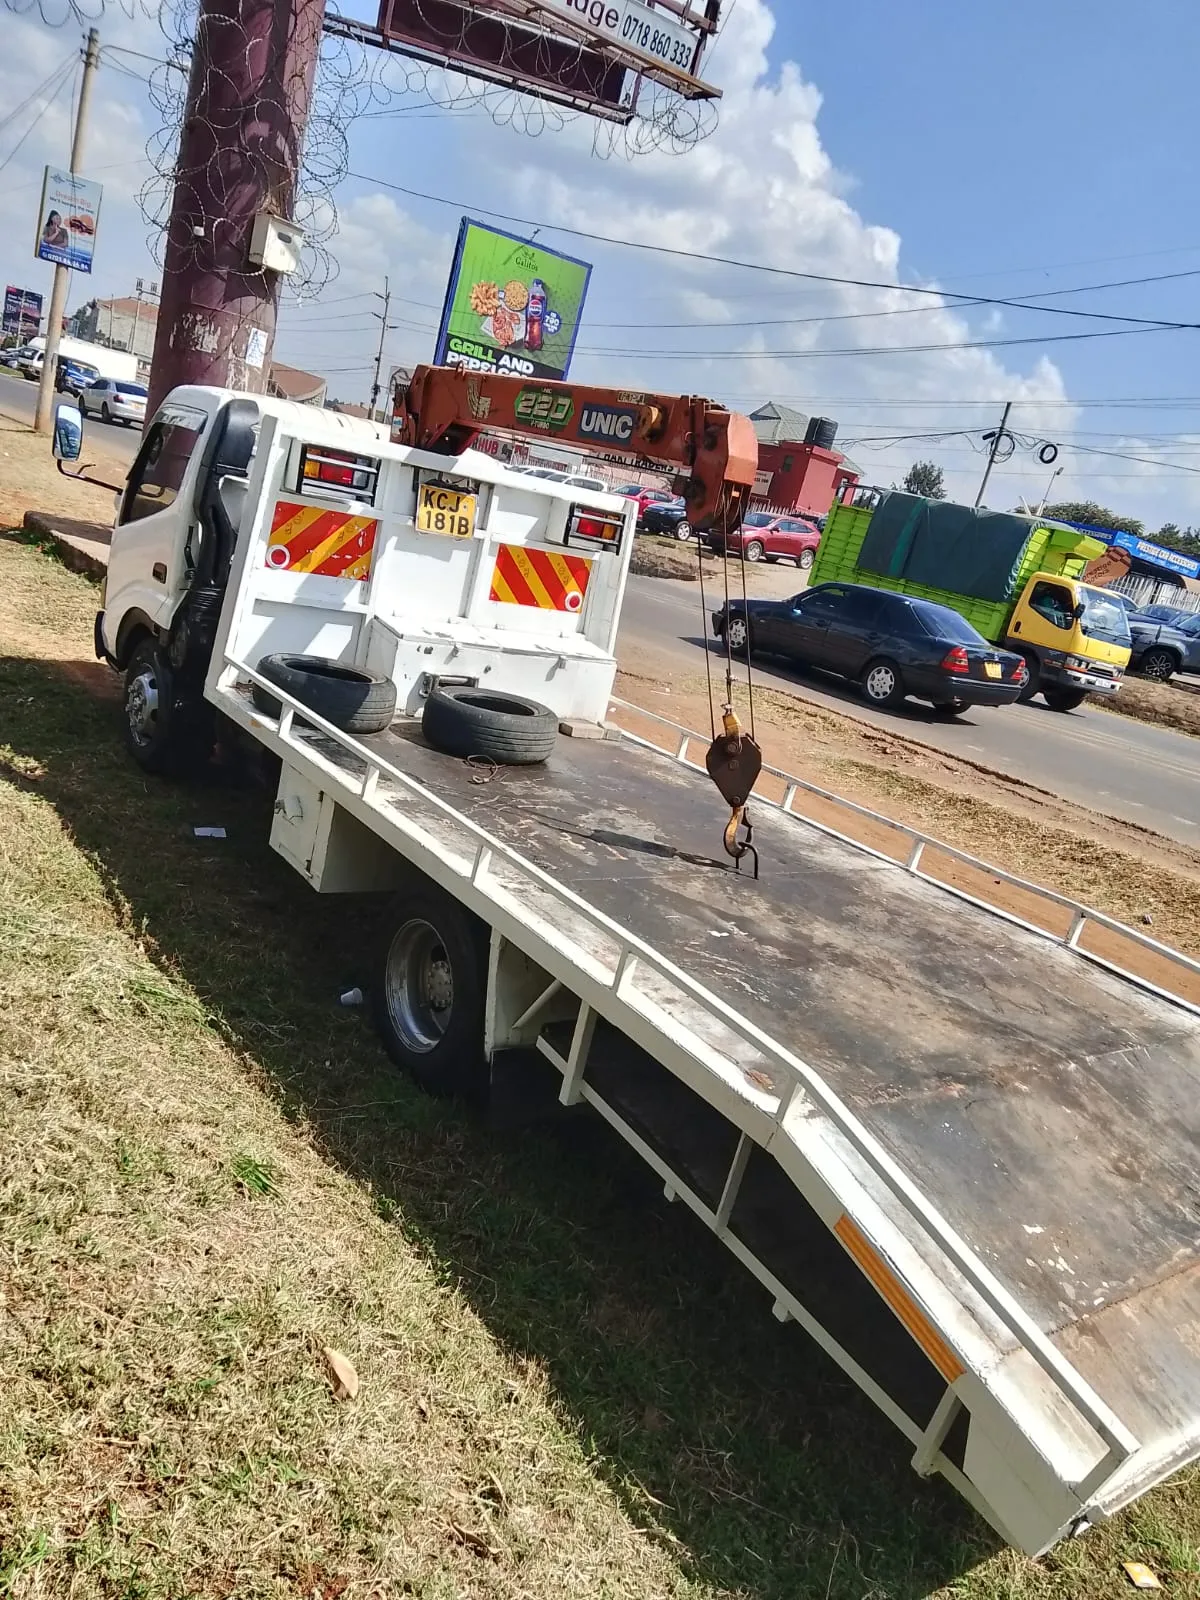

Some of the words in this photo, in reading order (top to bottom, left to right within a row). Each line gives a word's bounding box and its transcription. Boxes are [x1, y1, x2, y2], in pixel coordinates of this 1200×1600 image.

[622, 14, 651, 47] 0718
[649, 29, 671, 58] 860
[669, 39, 692, 68] 333
[449, 338, 497, 363] GRILL
[498, 354, 534, 375] AND
[517, 393, 571, 419] 220
[580, 409, 633, 439] UNIC
[424, 488, 462, 513] KCJ
[426, 510, 470, 536] 181B
